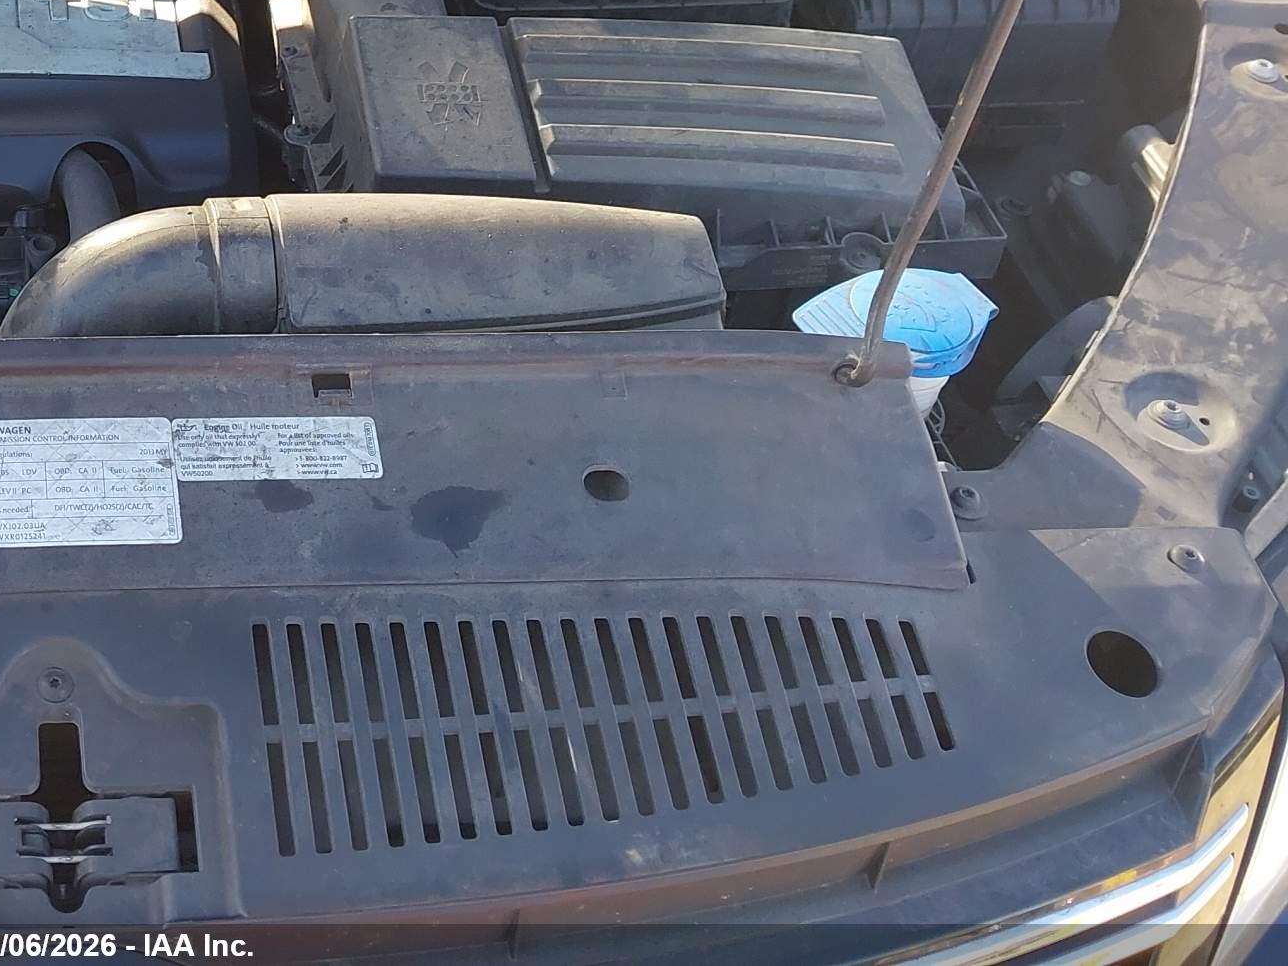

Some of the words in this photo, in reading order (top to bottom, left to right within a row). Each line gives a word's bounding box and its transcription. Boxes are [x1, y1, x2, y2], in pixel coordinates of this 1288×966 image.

[32, 434, 68, 442] CONTROL
[68, 433, 120, 442] INFORMATION
[131, 465, 166, 474] Gasoline
[132, 484, 167, 492] Gasoline
